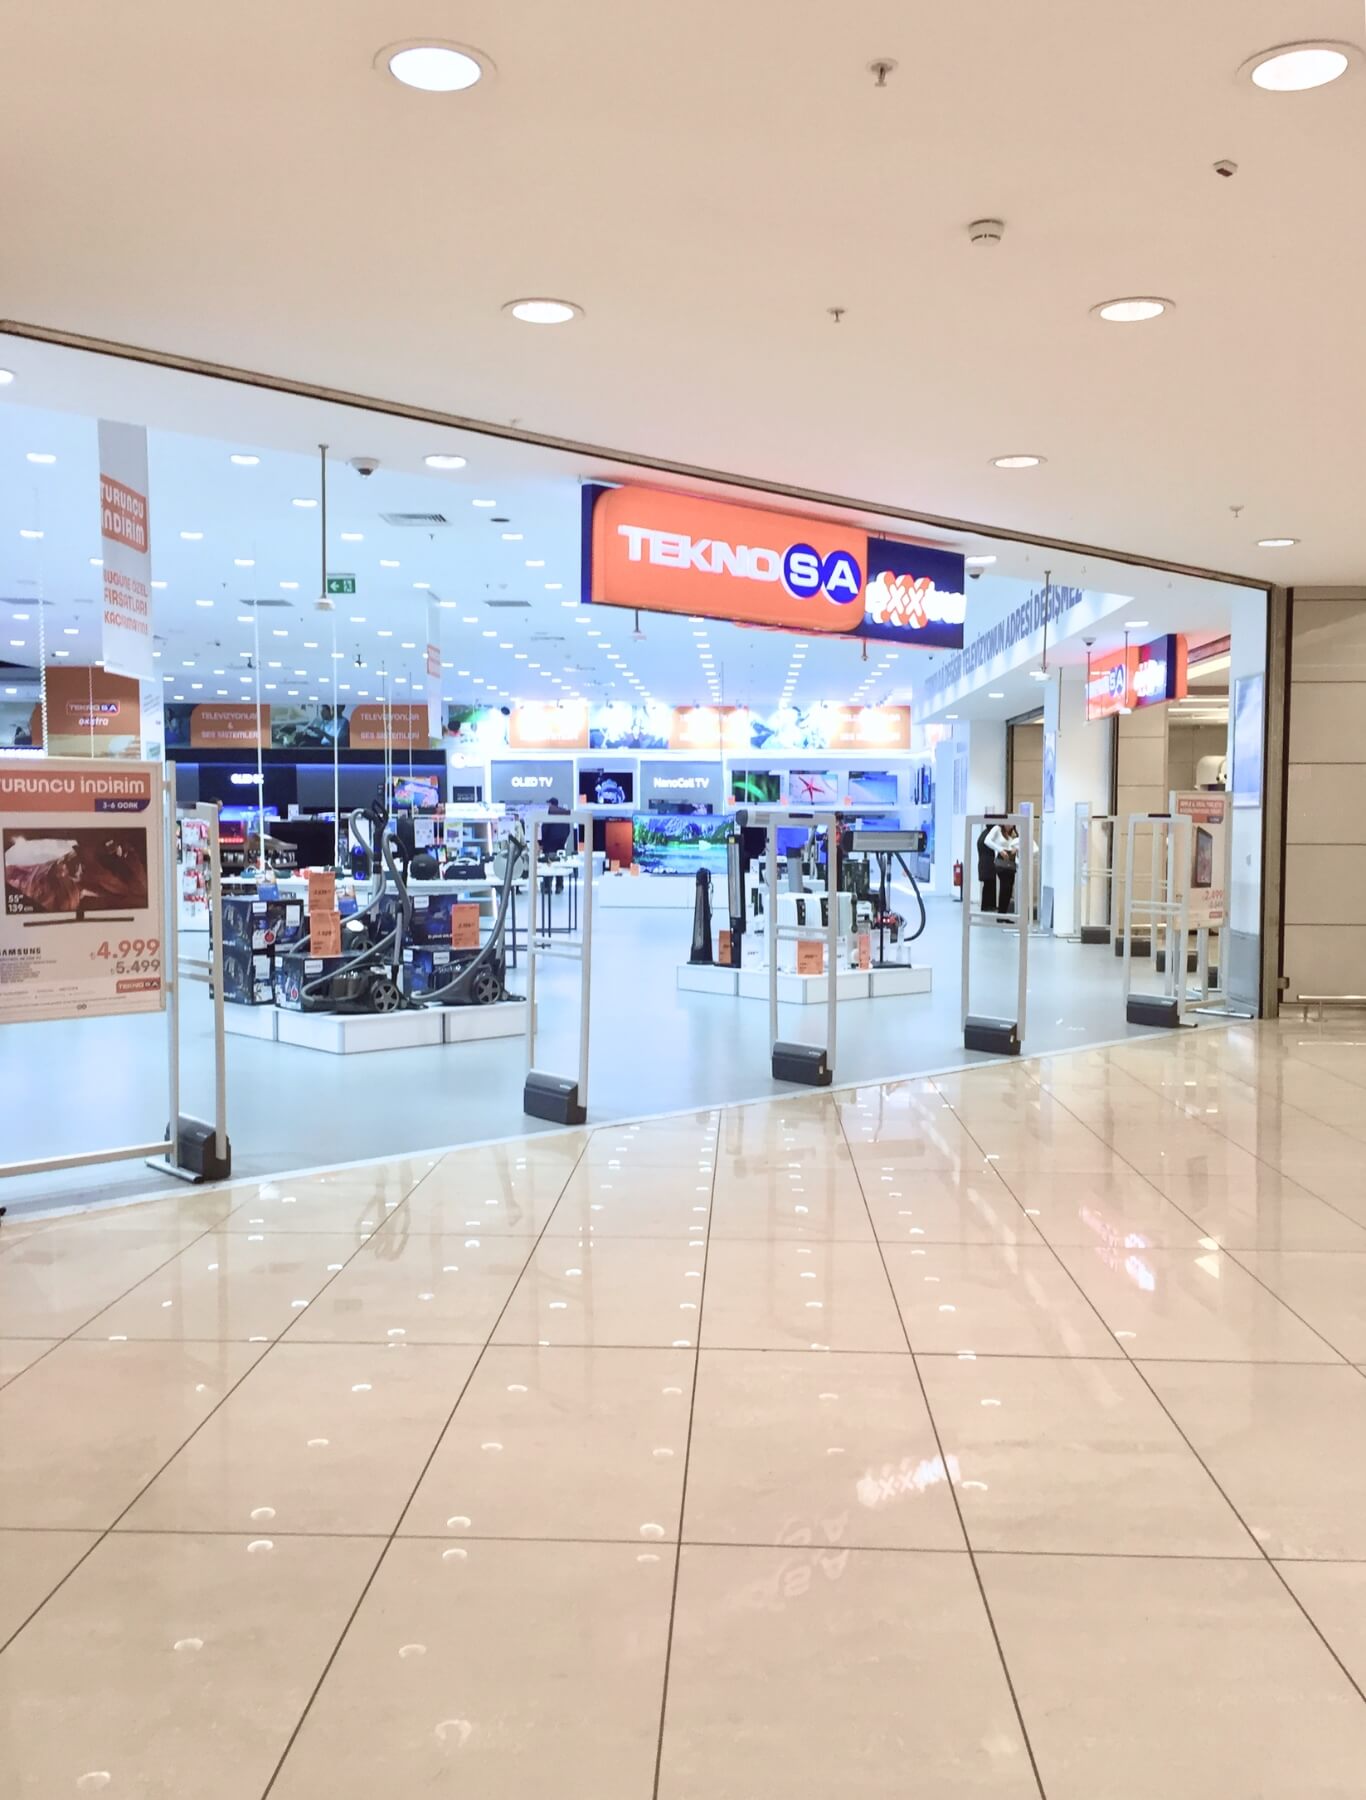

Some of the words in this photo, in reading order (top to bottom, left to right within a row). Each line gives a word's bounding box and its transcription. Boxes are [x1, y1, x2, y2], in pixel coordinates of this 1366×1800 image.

[617, 524, 860, 598] TEKNOSA
[0, 778, 75, 794] URUNCU
[511, 776, 538, 788] OLED
[539, 776, 553, 788] TV
[696, 777, 710, 789] TV
